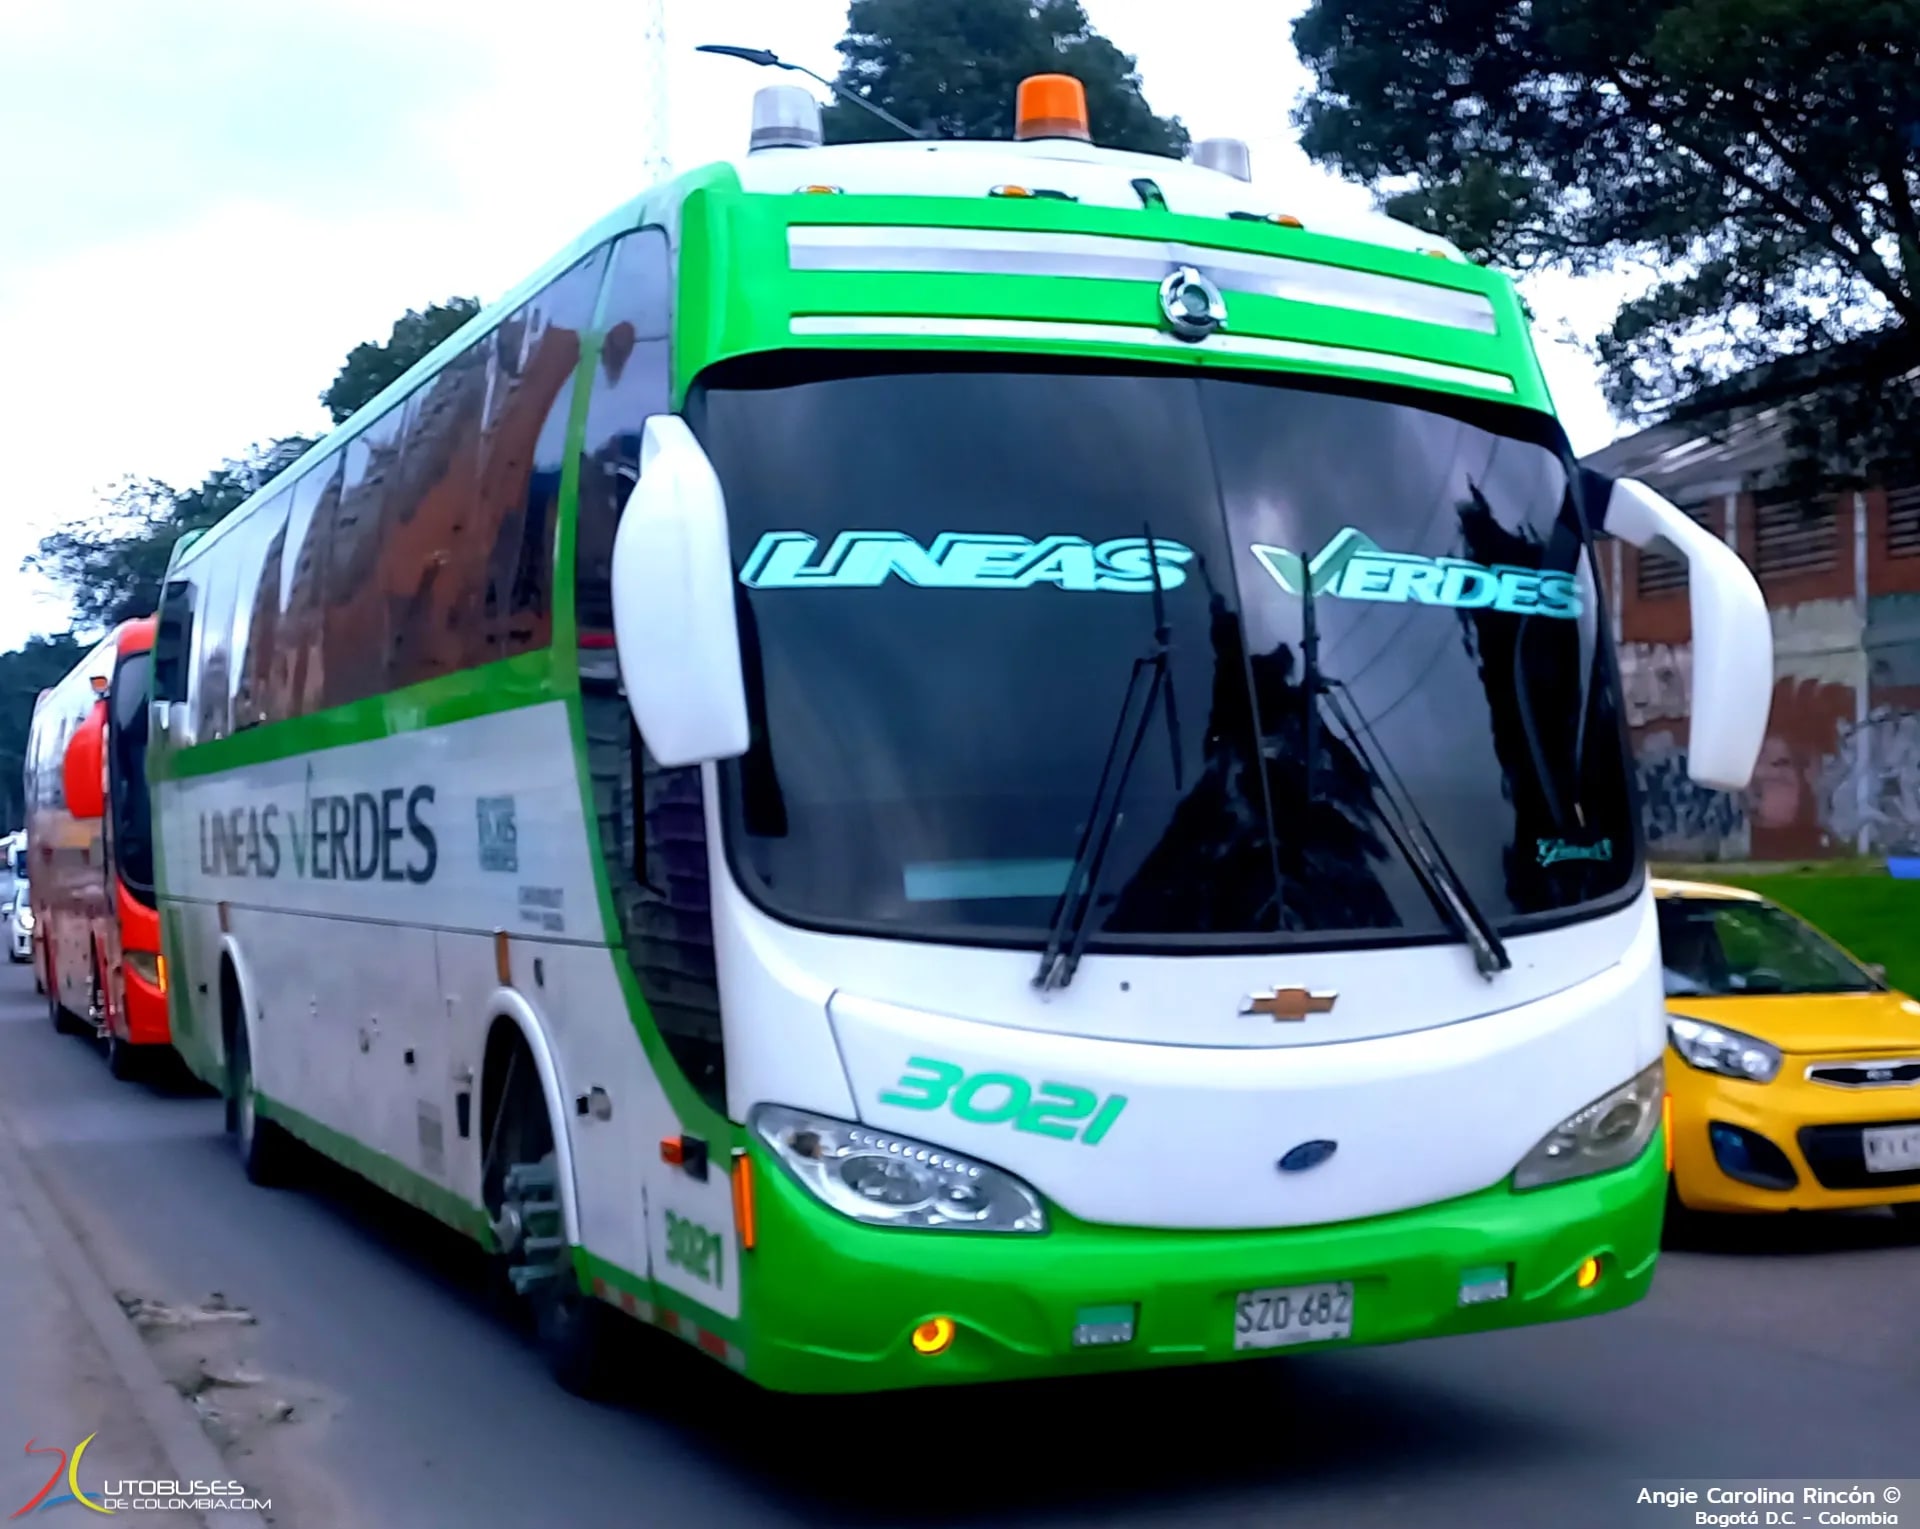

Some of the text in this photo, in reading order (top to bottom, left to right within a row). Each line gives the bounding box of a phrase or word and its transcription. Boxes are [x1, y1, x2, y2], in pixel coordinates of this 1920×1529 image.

[739, 527, 1584, 619] LINEAS VERDES
[199, 803, 281, 879] LINEAS
[285, 760, 439, 885] VERDES
[879, 1056, 1128, 1145] 3021
[665, 1209, 723, 1290] 3021
